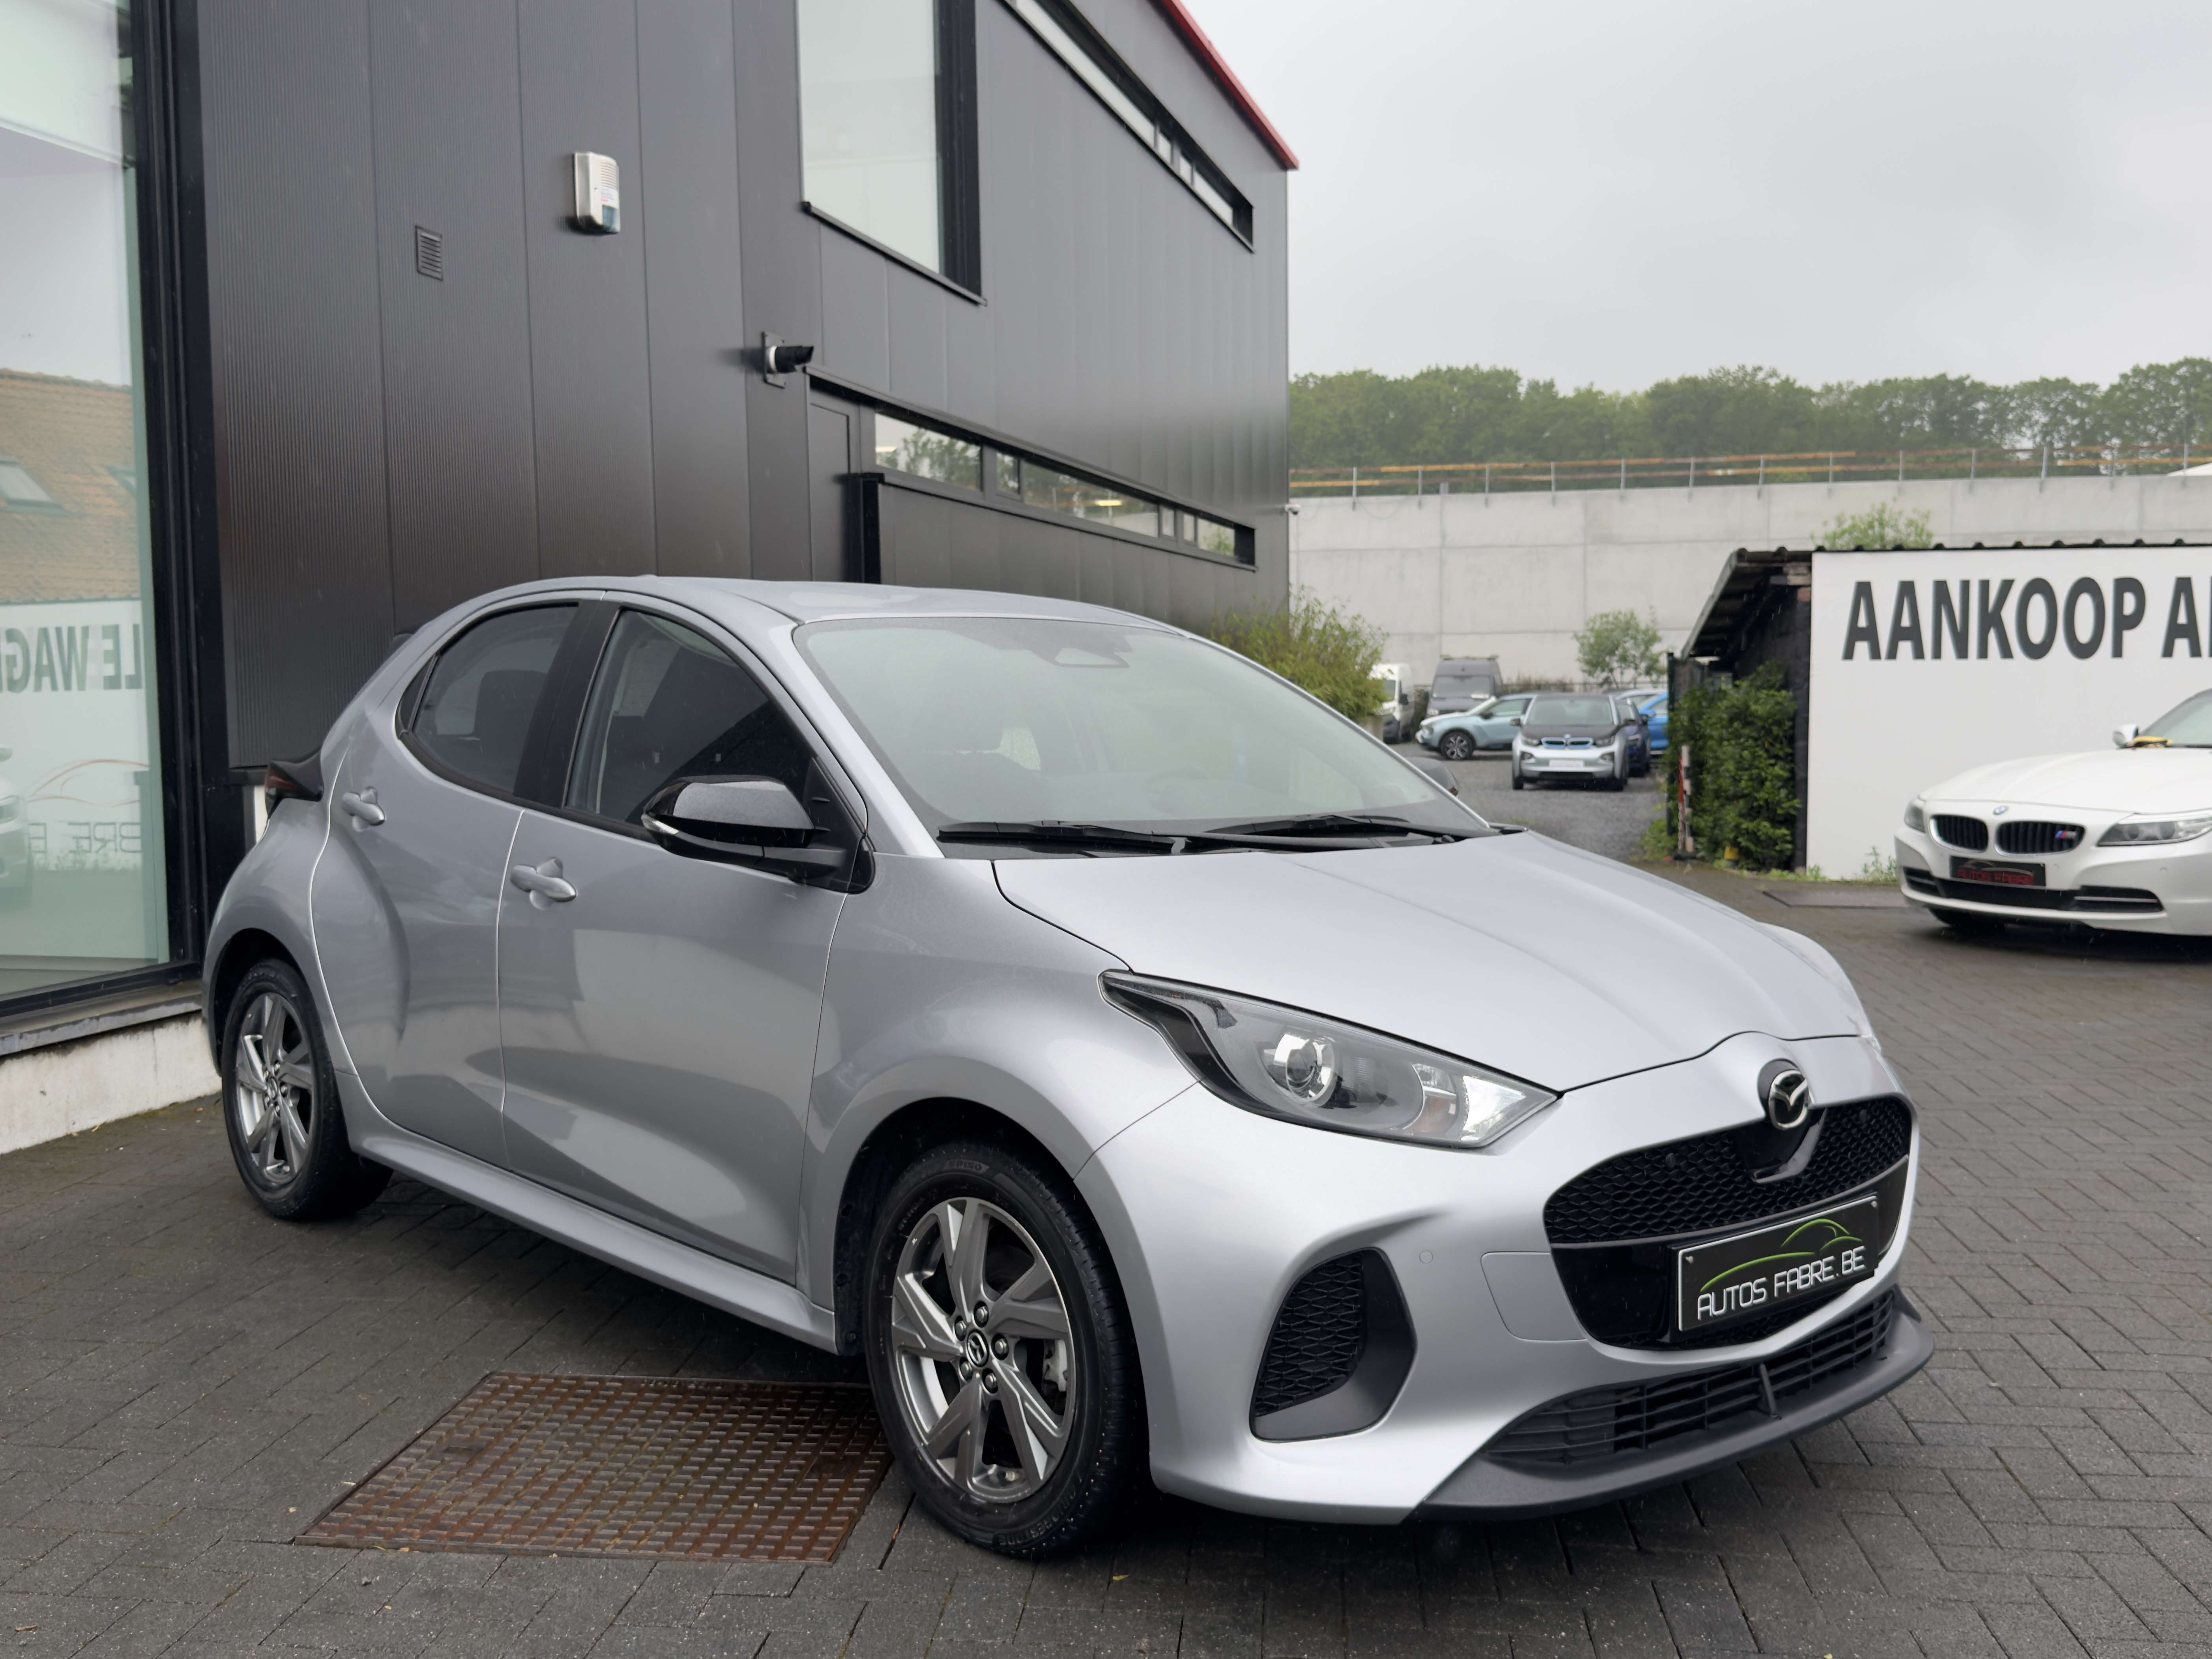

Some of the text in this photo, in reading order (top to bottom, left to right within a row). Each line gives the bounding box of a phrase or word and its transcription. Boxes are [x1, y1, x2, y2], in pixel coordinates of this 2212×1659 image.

[1842, 577, 2212, 660] AANKOOP A
[1697, 1245, 1866, 1320] AUTOS FABRE.BE
